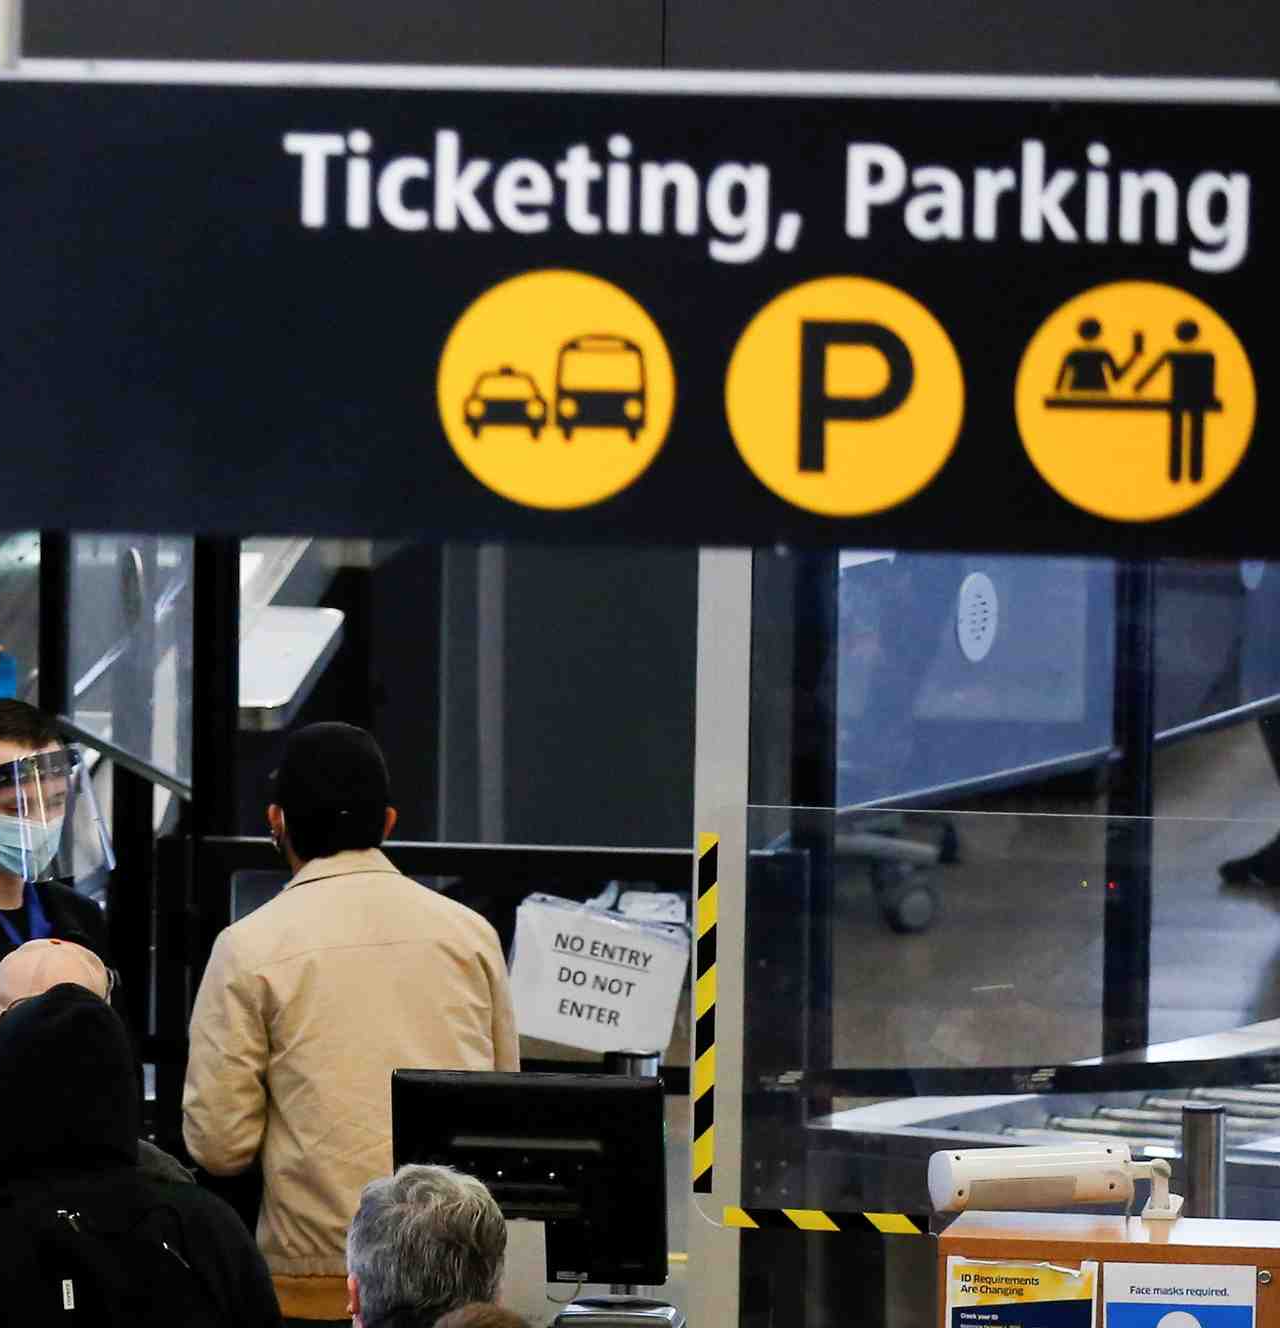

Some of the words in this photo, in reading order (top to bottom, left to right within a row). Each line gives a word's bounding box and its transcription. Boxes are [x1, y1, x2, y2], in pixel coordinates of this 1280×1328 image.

[284, 130, 803, 264] Ticketing,
[843, 142, 1252, 273] Parking
[799, 320, 915, 471] P
[554, 932, 584, 953] NO
[590, 940, 653, 968] ENTRY
[557, 966, 587, 986] DO
[592, 974, 637, 998] NOT
[557, 998, 621, 1027] ENTER
[960, 1285, 978, 1294] Are
[979, 1286, 1024, 1296] Changing
[961, 1274, 971, 1282] ID
[973, 1274, 1040, 1286] Requirements
[1130, 1285, 1151, 1295] Face
[1153, 1286, 1184, 1295] masks
[1186, 1287, 1230, 1297] required.
